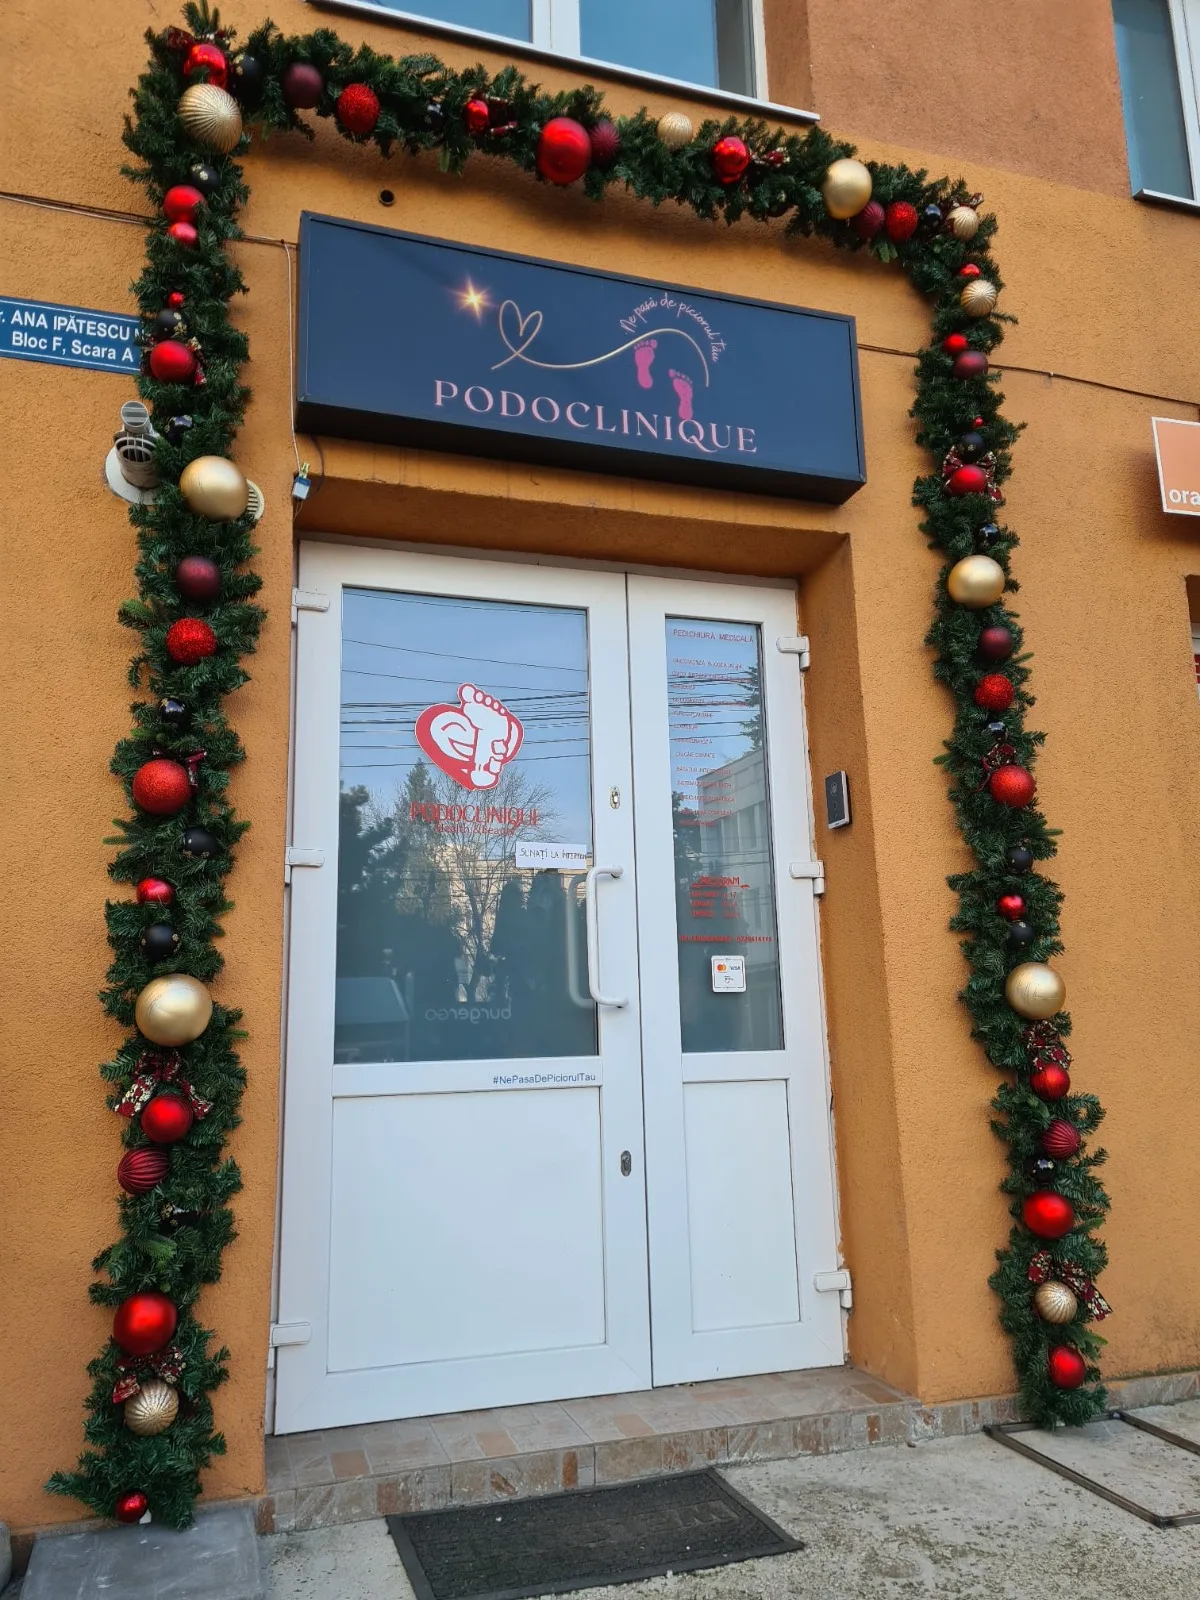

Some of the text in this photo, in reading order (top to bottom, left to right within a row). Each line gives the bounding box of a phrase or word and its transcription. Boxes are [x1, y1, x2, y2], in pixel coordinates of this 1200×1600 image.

[11, 309, 48, 329] ANA
[53, 315, 130, 341] IPĂTESCU
[619, 315, 637, 334] Ne
[660, 292, 677, 309] de
[676, 302, 721, 340] piciorul
[12, 331, 134, 362] Bloc F, Scara A
[433, 380, 758, 453] PODOCLINIQUE
[409, 801, 540, 827] PODOCLINIQUE
[492, 1073, 596, 1085] #NePasaDePiciorulTau
